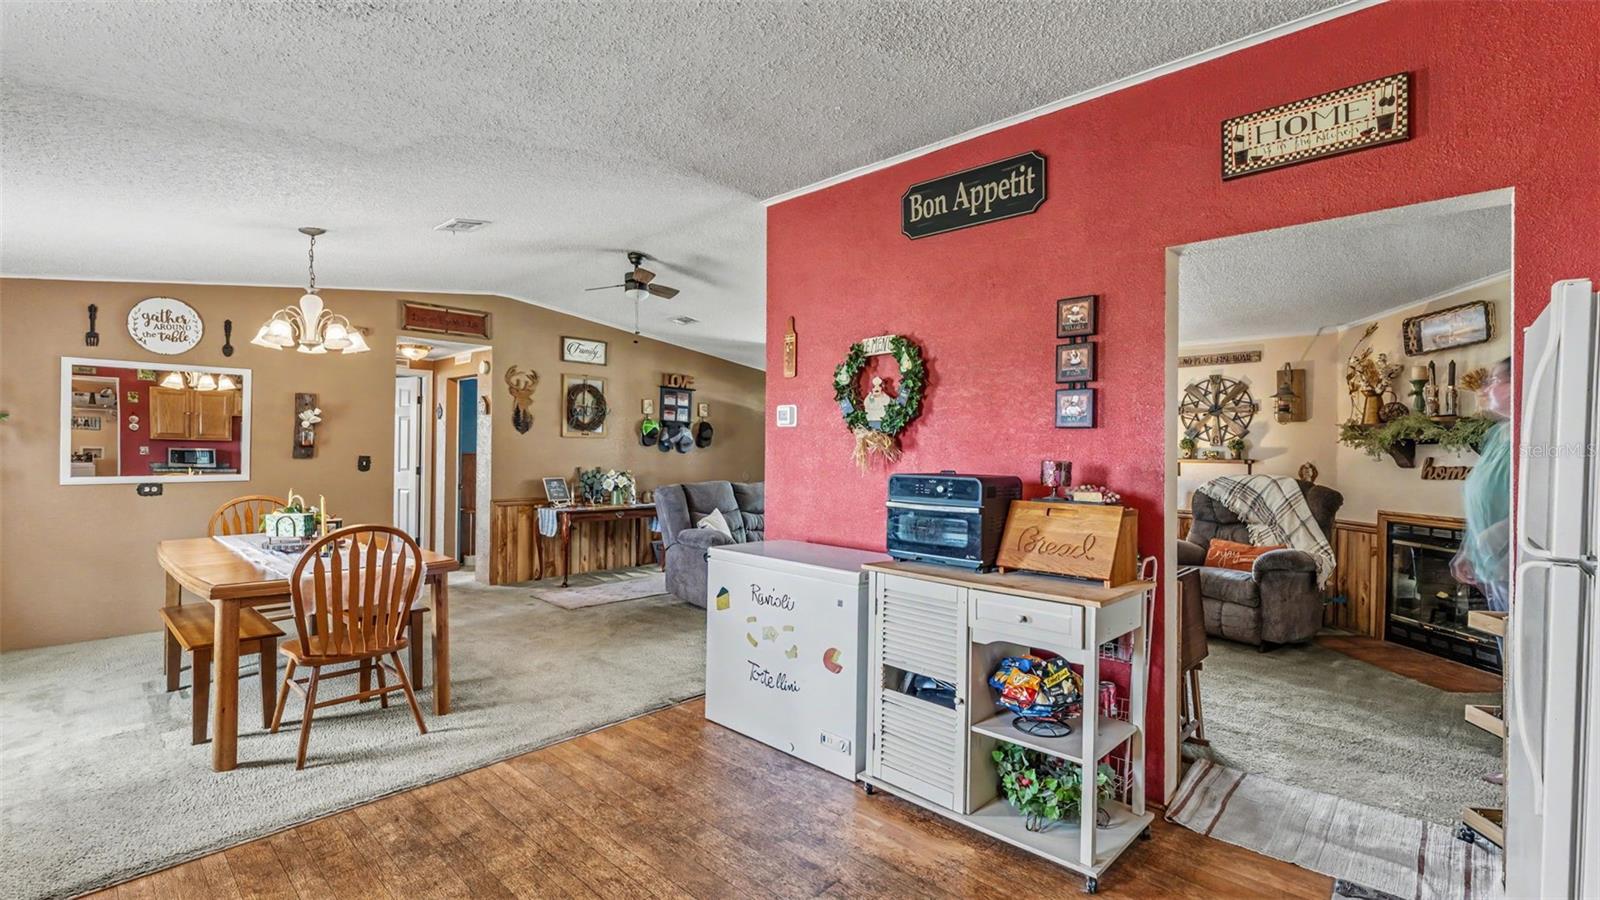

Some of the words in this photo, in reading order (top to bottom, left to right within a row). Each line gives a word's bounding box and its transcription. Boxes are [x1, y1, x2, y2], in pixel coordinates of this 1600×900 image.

[1256, 97, 1369, 145] HOME
[909, 193, 948, 222] Bon
[952, 164, 1036, 216] Appetit
[141, 309, 188, 327] gather
[153, 323, 191, 331] AROUND
[158, 330, 190, 343] table
[661, 372, 694, 388] LOVE
[1017, 525, 1096, 561] Bread
[750, 583, 795, 611] Ravioli
[747, 659, 801, 692] Tortellini
